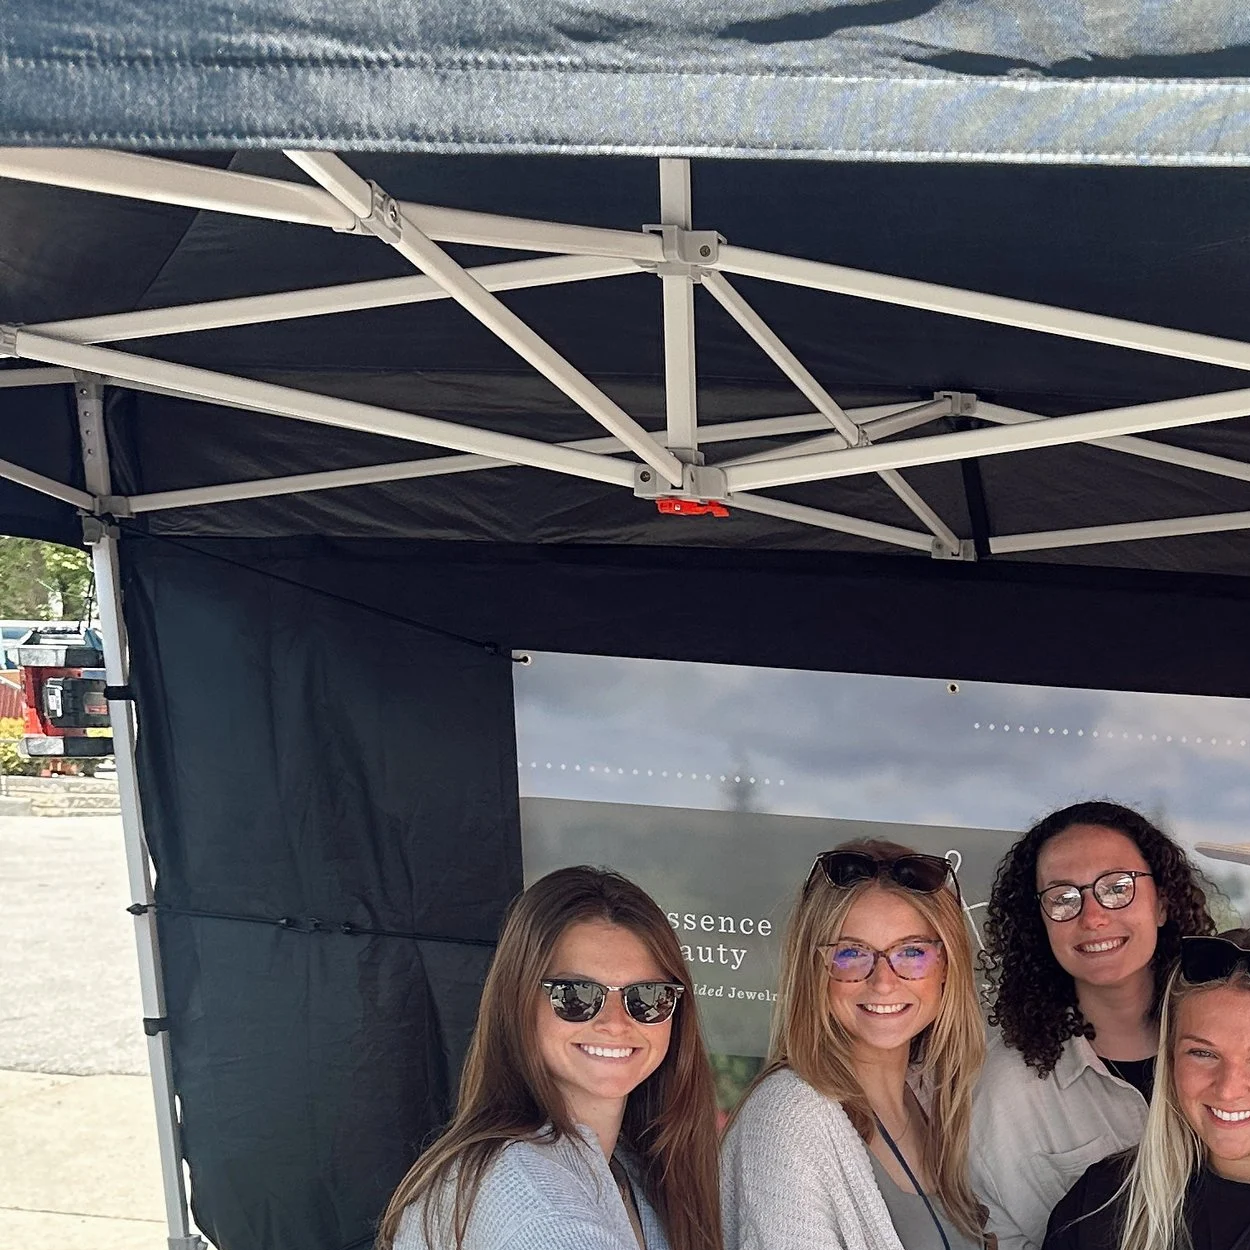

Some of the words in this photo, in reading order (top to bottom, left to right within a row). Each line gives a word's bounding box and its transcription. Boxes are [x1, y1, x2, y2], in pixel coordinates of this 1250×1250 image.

[667, 912, 773, 937] ssence
[680, 943, 748, 970] auty
[694, 983, 724, 997] lded
[728, 987, 778, 1001] Jewelr
